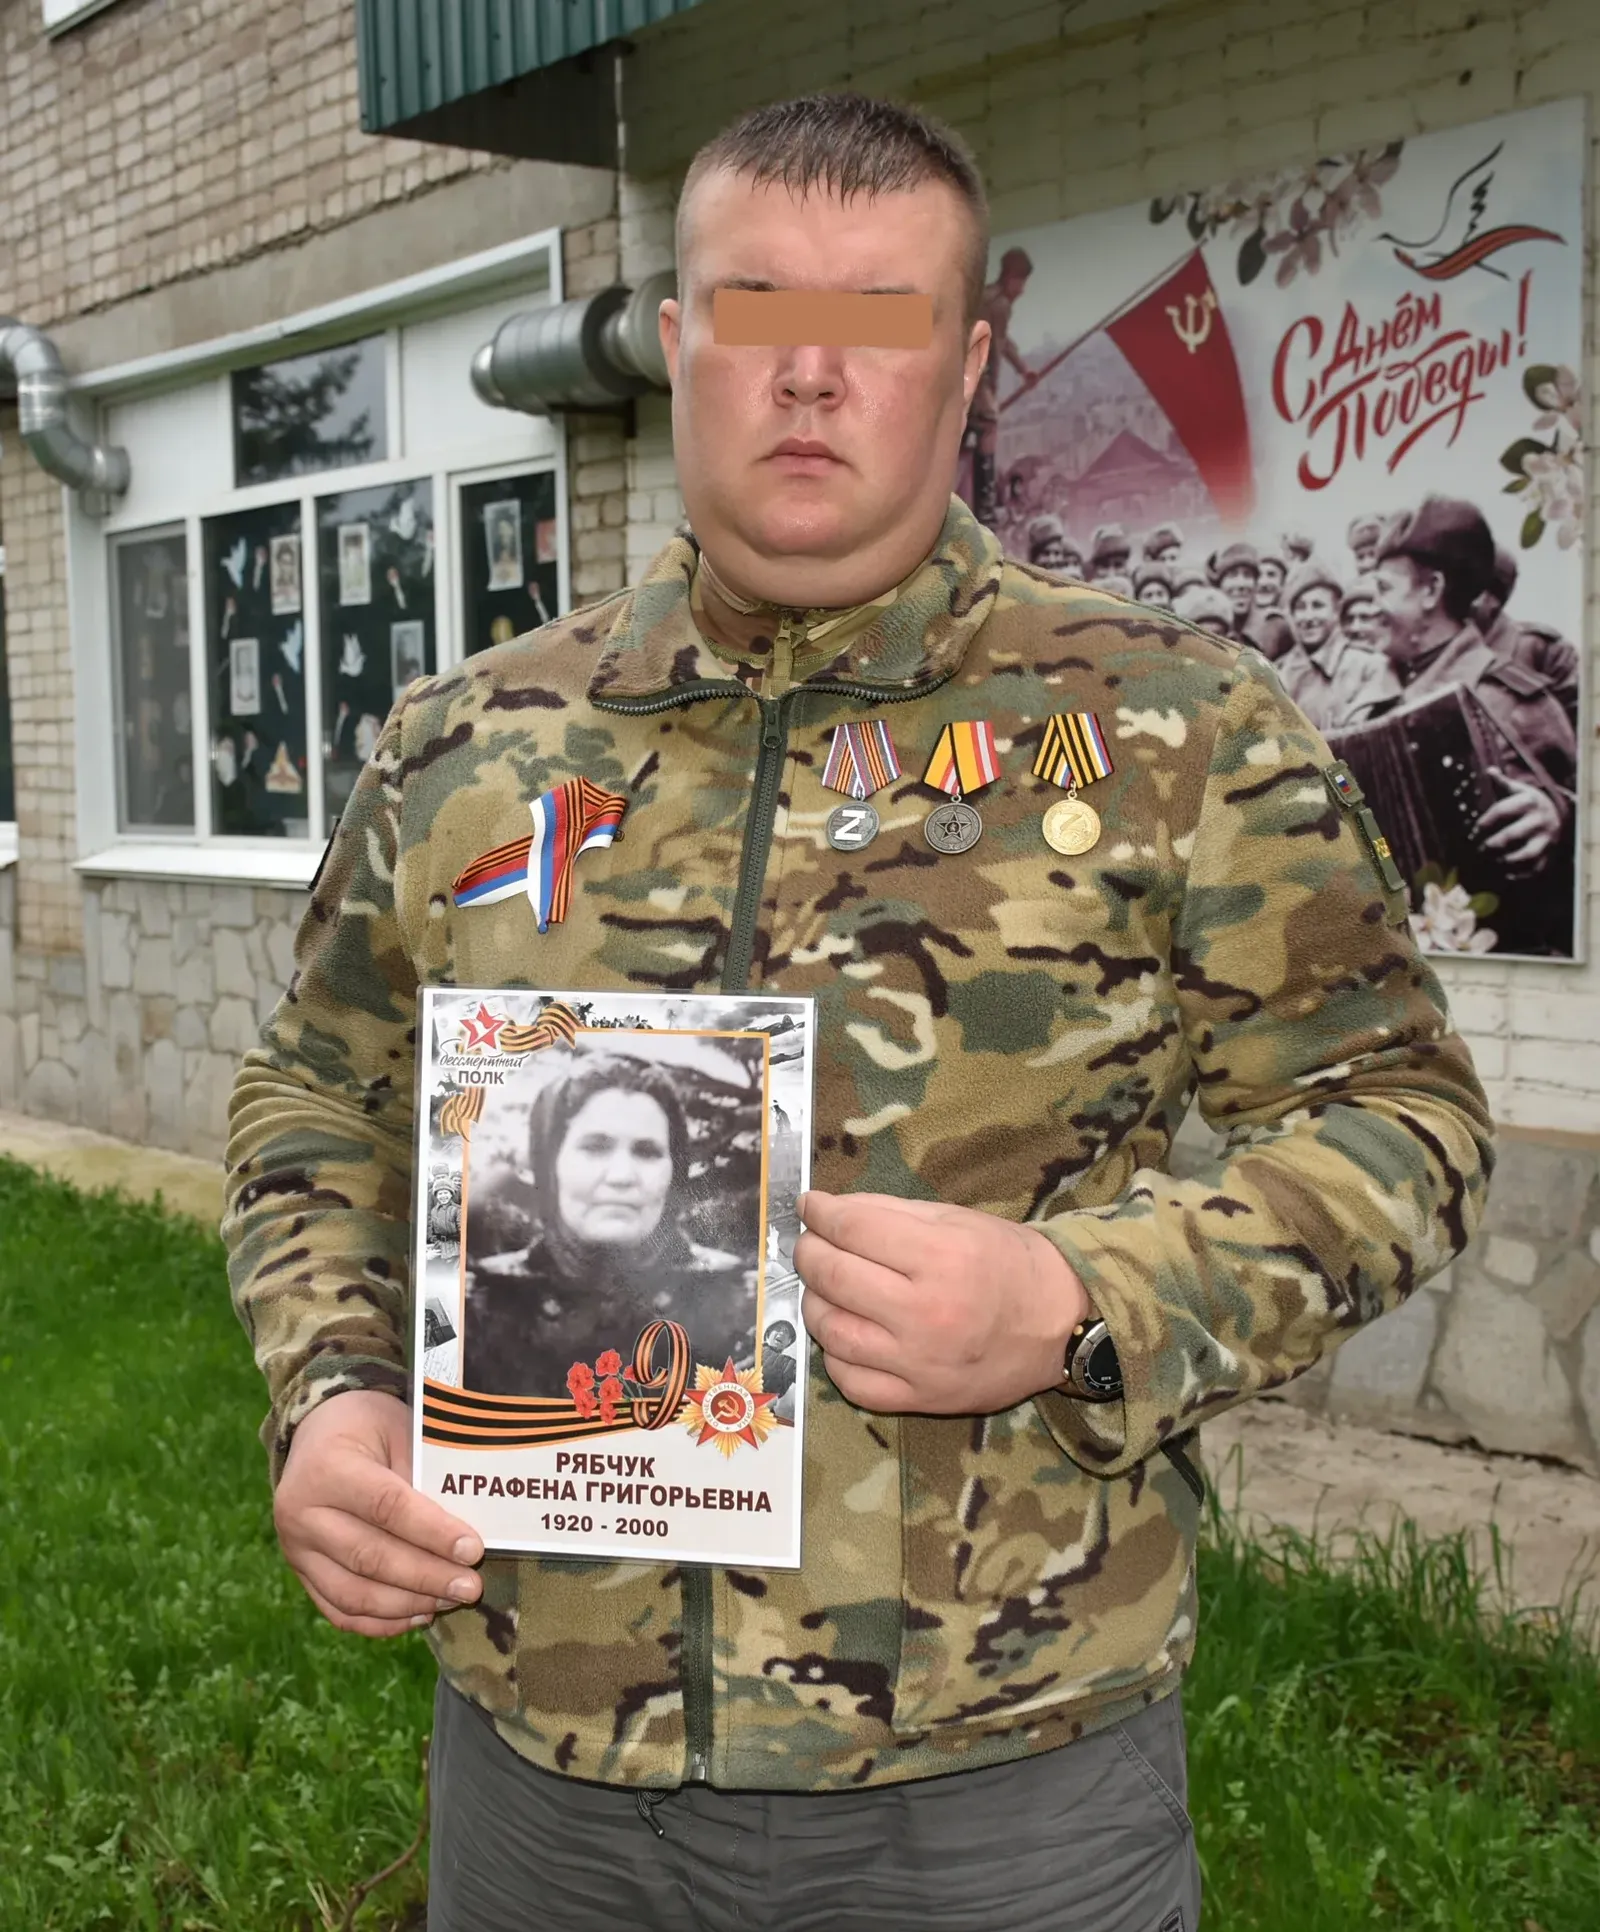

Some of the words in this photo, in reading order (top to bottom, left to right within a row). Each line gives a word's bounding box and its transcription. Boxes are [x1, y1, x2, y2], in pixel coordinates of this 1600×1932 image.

[1272, 314, 1324, 424] С
[1297, 266, 1534, 491] Победы!
[834, 809, 867, 841] Z
[458, 1070, 505, 1085] ПОЛК
[556, 1451, 656, 1479] РЯБЧУК
[440, 1473, 578, 1502] АГРАФЕНА
[586, 1481, 772, 1513] ГРИГОРЬЕВНА
[541, 1513, 593, 1533] 1920
[615, 1517, 669, 1538] 2000
